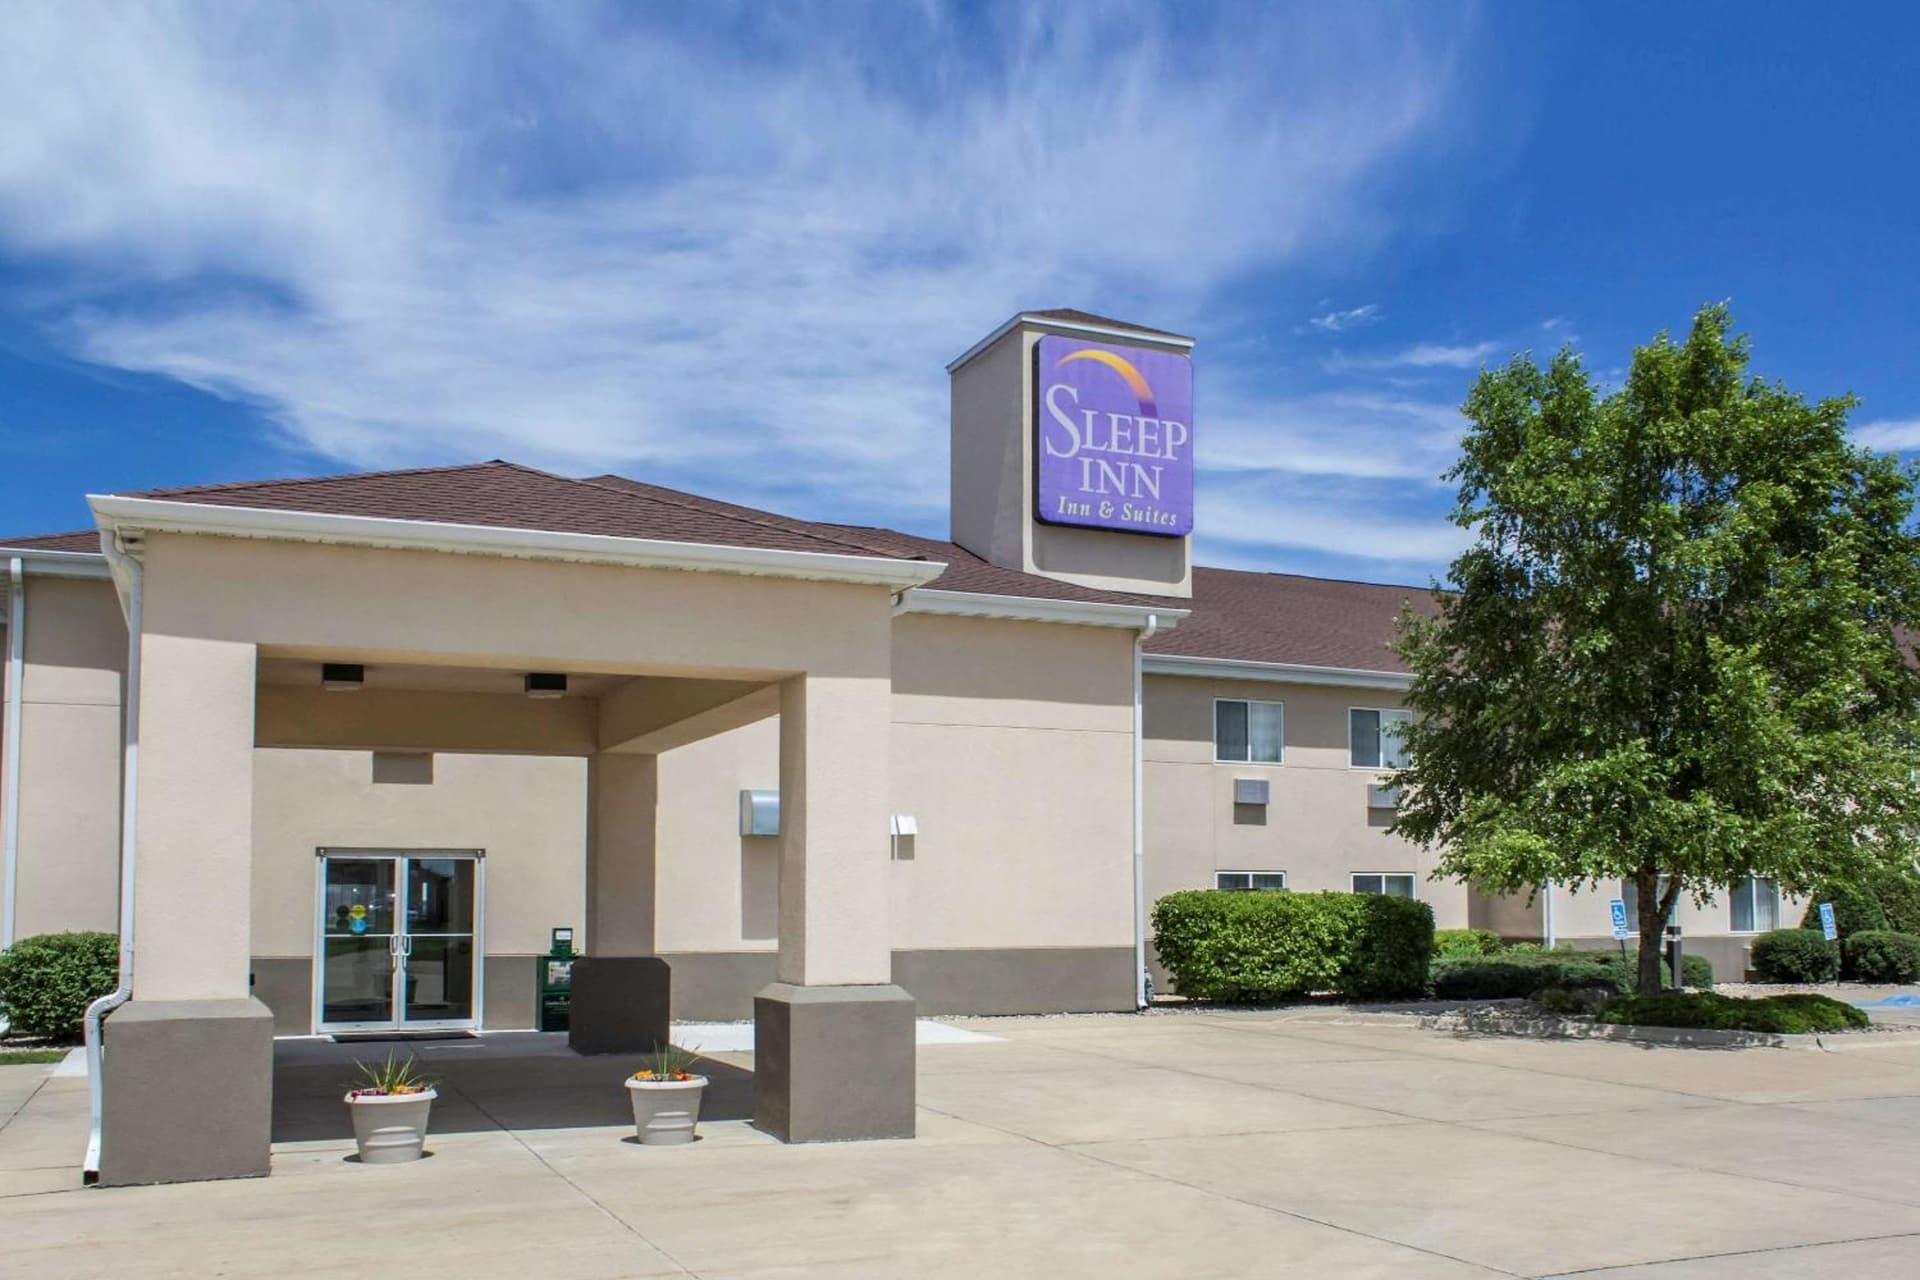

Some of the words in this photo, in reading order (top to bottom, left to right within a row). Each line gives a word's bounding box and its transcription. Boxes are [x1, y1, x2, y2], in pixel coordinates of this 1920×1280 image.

[1046, 384, 1187, 460] SLEEP
[1078, 457, 1163, 500] INN
[1058, 496, 1090, 516] Inn
[1098, 501, 1114, 518] &
[1121, 503, 1177, 526] Suites
